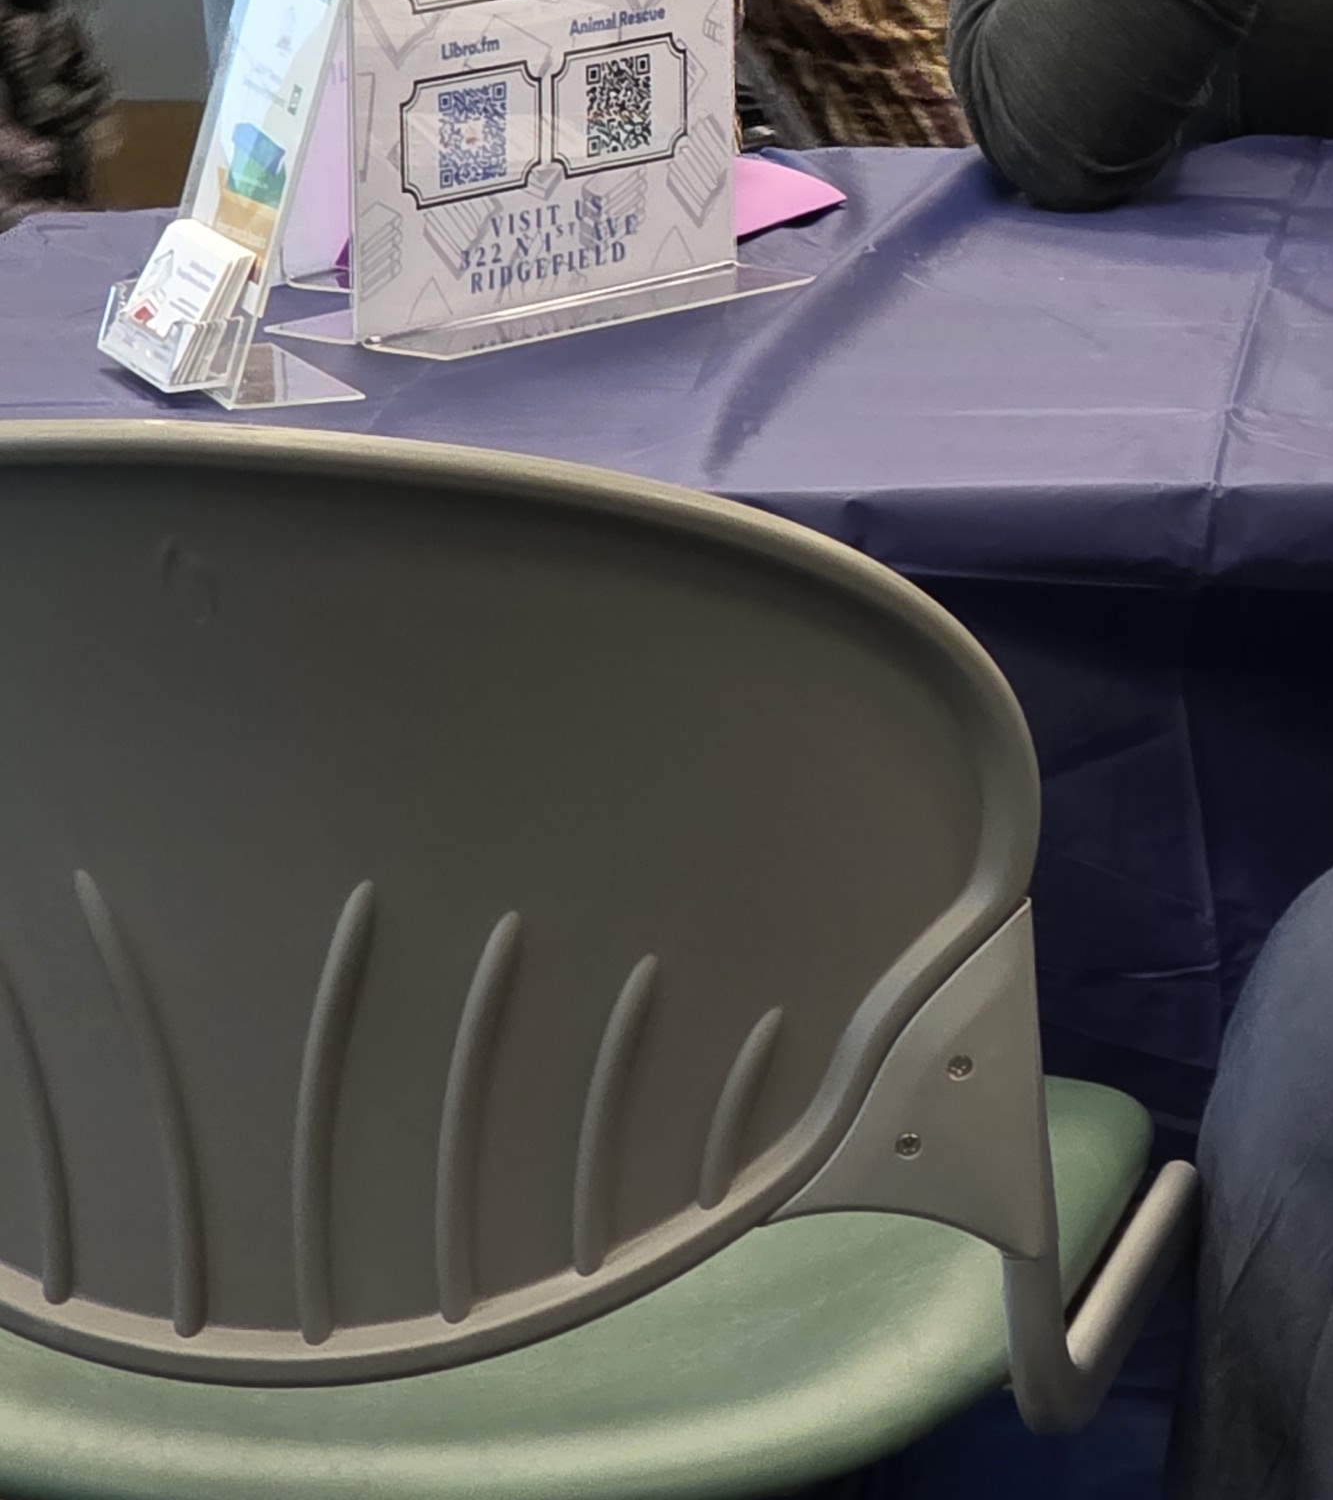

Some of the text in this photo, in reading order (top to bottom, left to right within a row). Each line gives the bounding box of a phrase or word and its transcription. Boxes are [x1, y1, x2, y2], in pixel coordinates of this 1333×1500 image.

[569, 5, 666, 37] Animal Rescue
[441, 35, 500, 61] Libro.fm
[491, 196, 603, 238] VISIT US
[459, 242, 503, 270] 322
[471, 241, 626, 295] RIDGEFIELD
